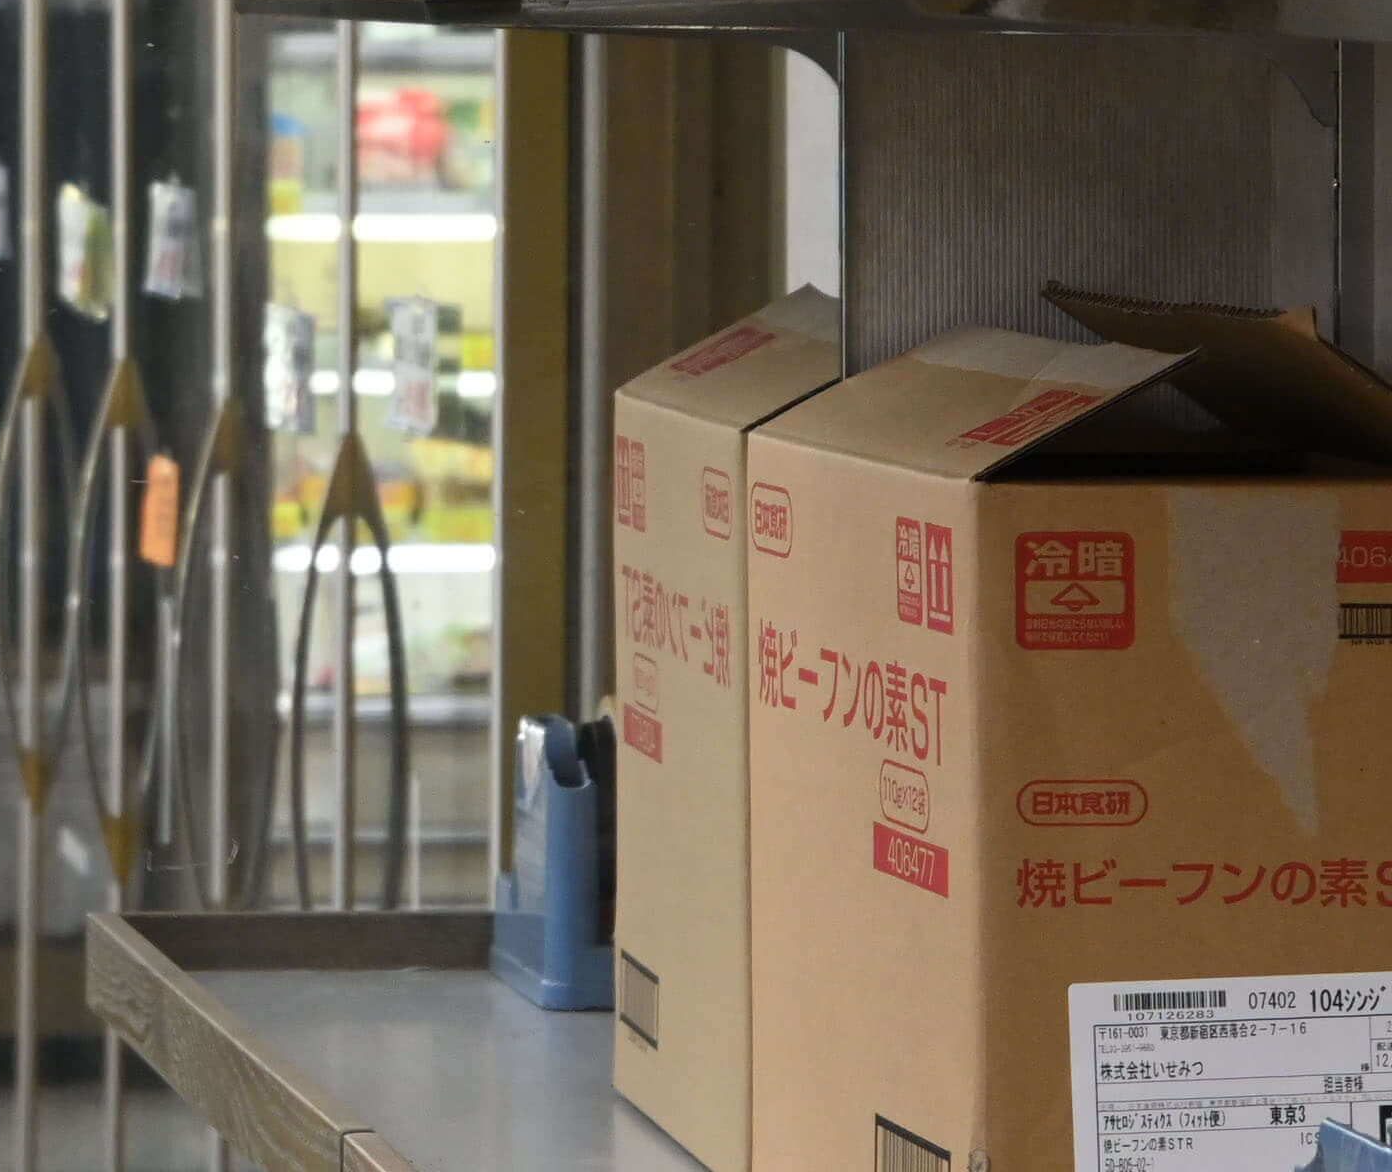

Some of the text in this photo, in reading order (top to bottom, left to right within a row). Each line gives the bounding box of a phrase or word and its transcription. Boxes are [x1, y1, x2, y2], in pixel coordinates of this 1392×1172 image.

[1025, 540, 1124, 576] 冷暗
[1334, 545, 1392, 569] 406
[758, 617, 948, 767] 焼ビーフンの素ST
[1031, 791, 1130, 816] 日本食研
[888, 835, 936, 886] 406477
[1248, 991, 1296, 1010] 07402
[1127, 1010, 1215, 1022] 107126283
[1100, 1060, 1204, 1081] 株式会社いせみつ
[1269, 1105, 1306, 1126] 東京3
